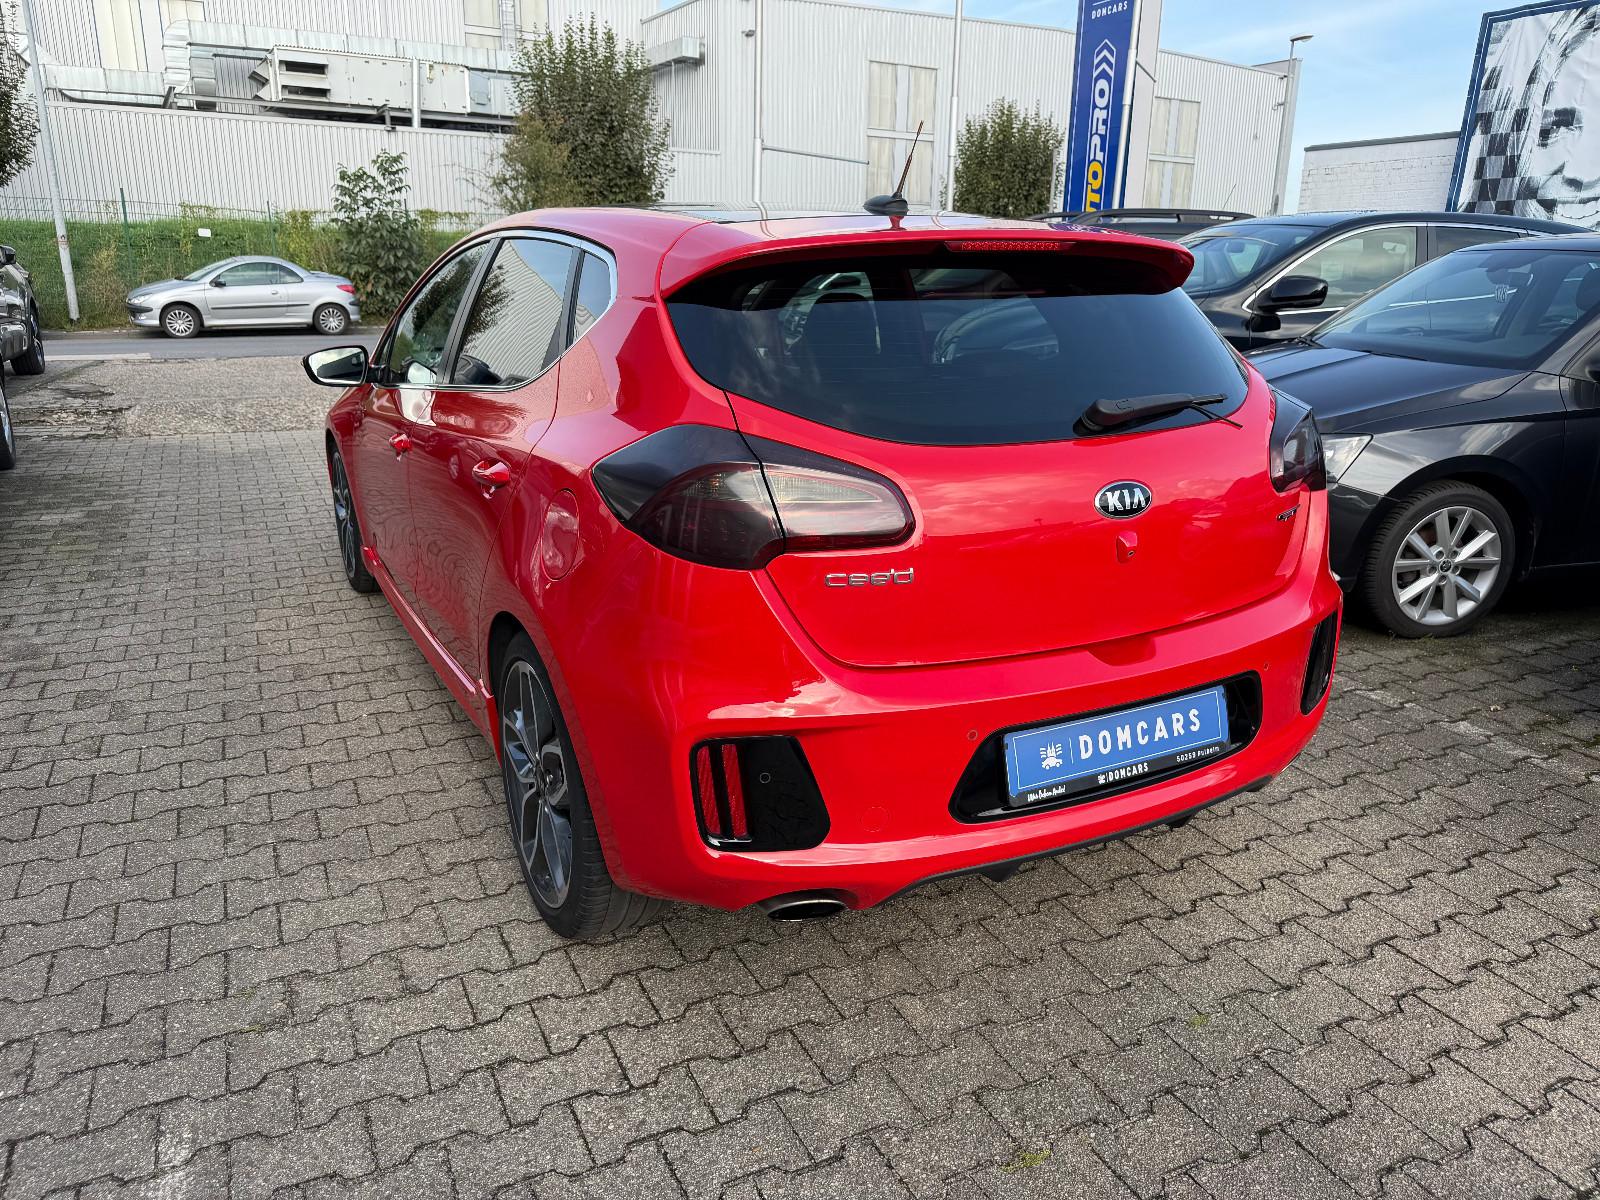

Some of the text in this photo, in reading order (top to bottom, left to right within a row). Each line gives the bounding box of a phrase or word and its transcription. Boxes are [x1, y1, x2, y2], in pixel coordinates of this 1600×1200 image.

[1091, 1, 1128, 19] DOMCARS
[1086, 78, 1110, 212] TOPRO
[1105, 487, 1146, 512] KIA
[825, 567, 914, 588] cee'd
[1079, 708, 1200, 760] DOMCARS
[1176, 751, 1196, 762] 50259
[1108, 762, 1149, 782] DOMCARS
